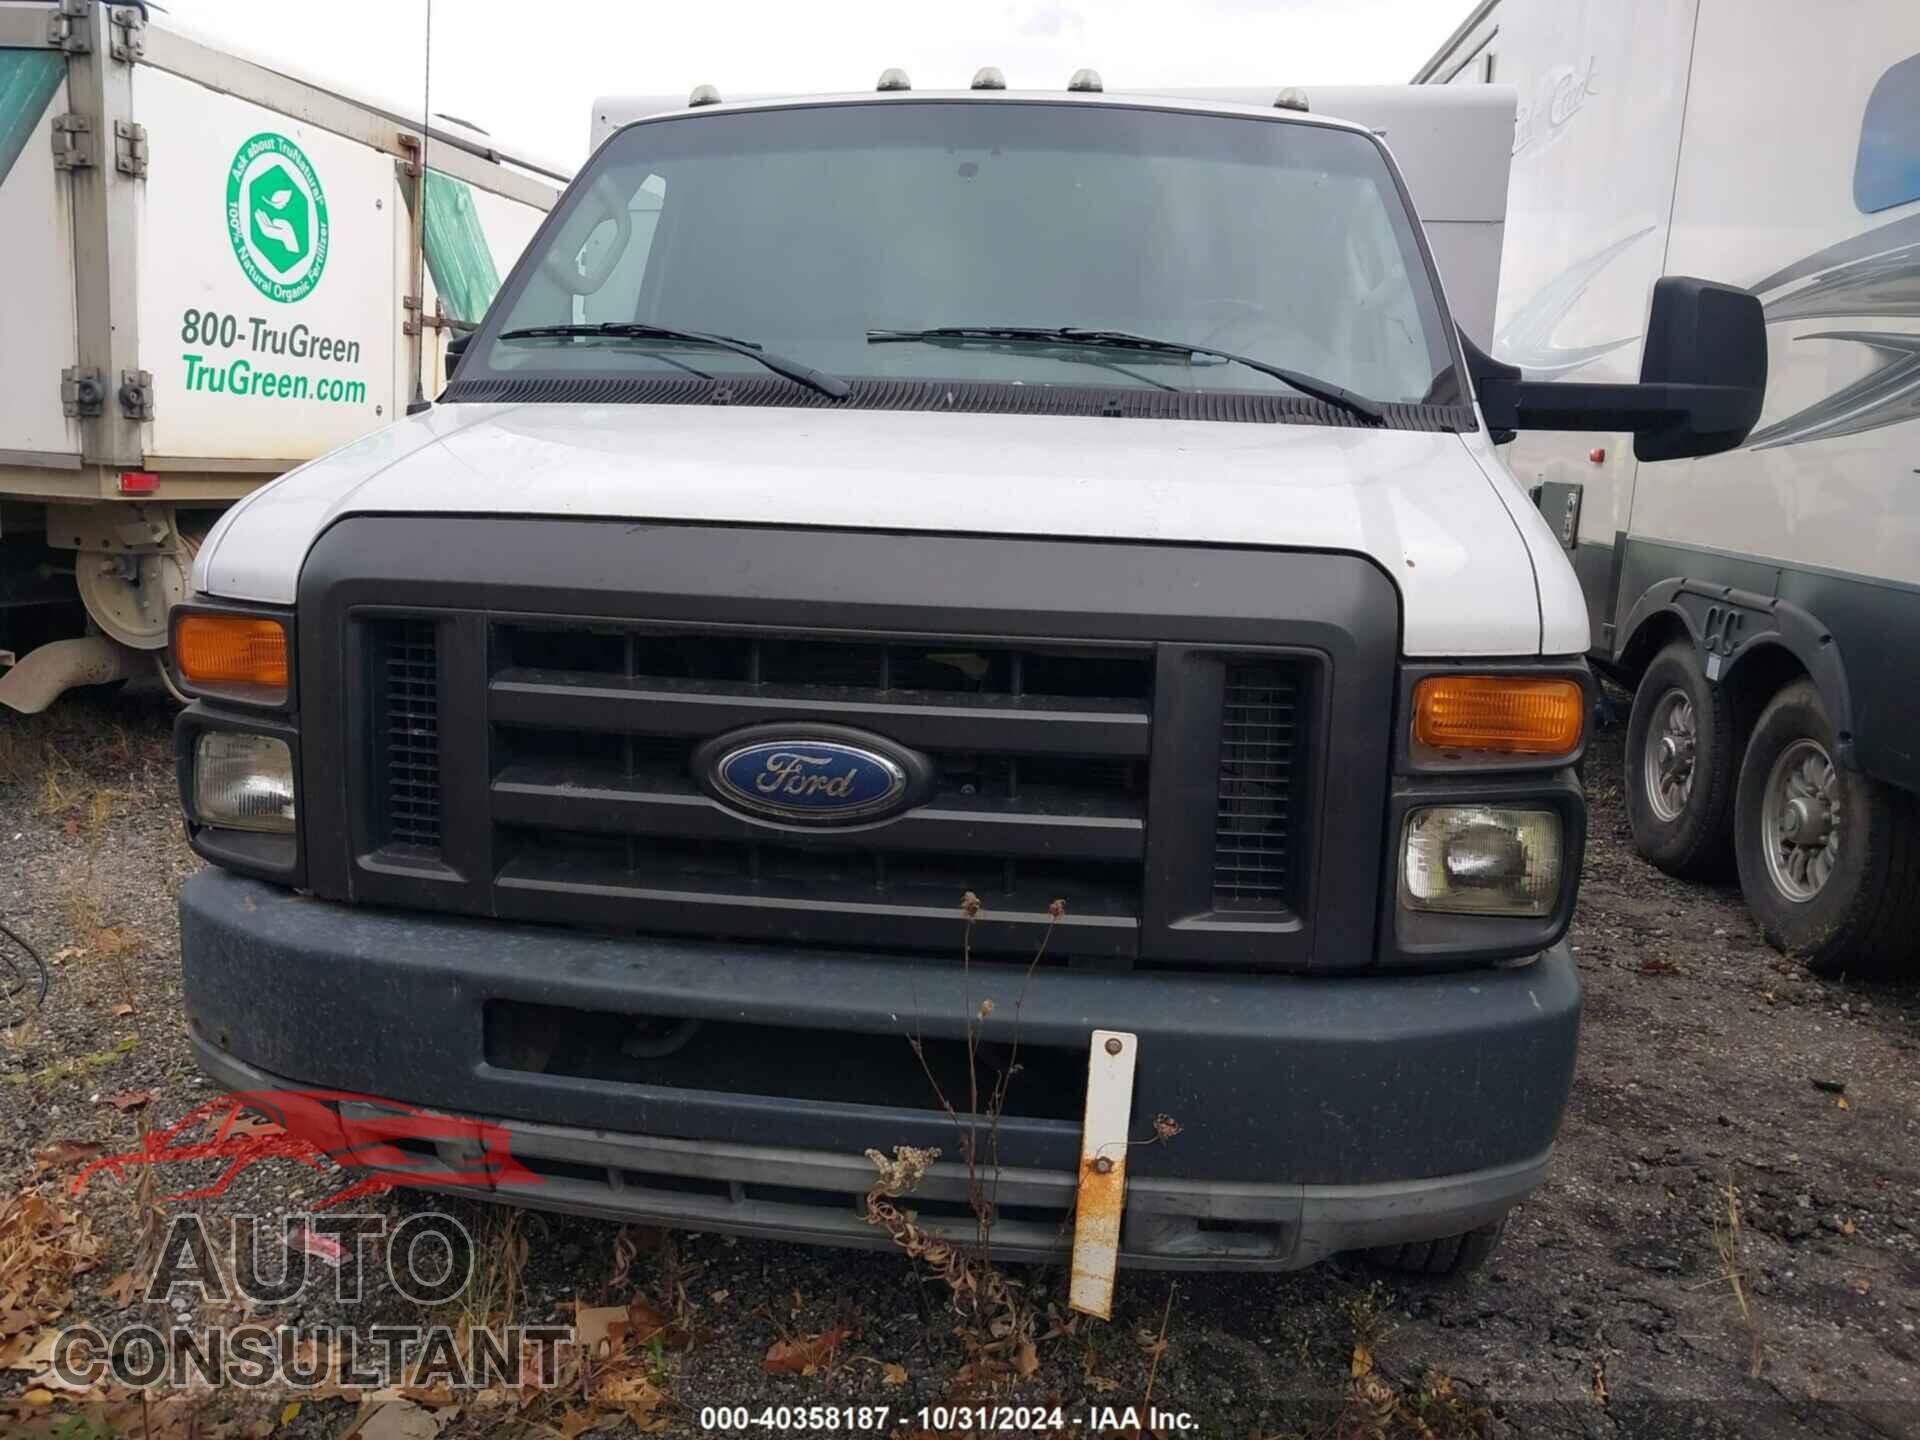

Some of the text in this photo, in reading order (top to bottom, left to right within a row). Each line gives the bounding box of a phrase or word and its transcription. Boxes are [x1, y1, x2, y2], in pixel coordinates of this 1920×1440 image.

[231, 154, 249, 183] Ask
[248, 138, 276, 156] about
[229, 201, 328, 302] 100% Natural Organic Fertilizer
[181, 308, 360, 363] 800-TruGreen
[182, 354, 367, 403] TruGreen.com
[756, 752, 858, 798] Ford
